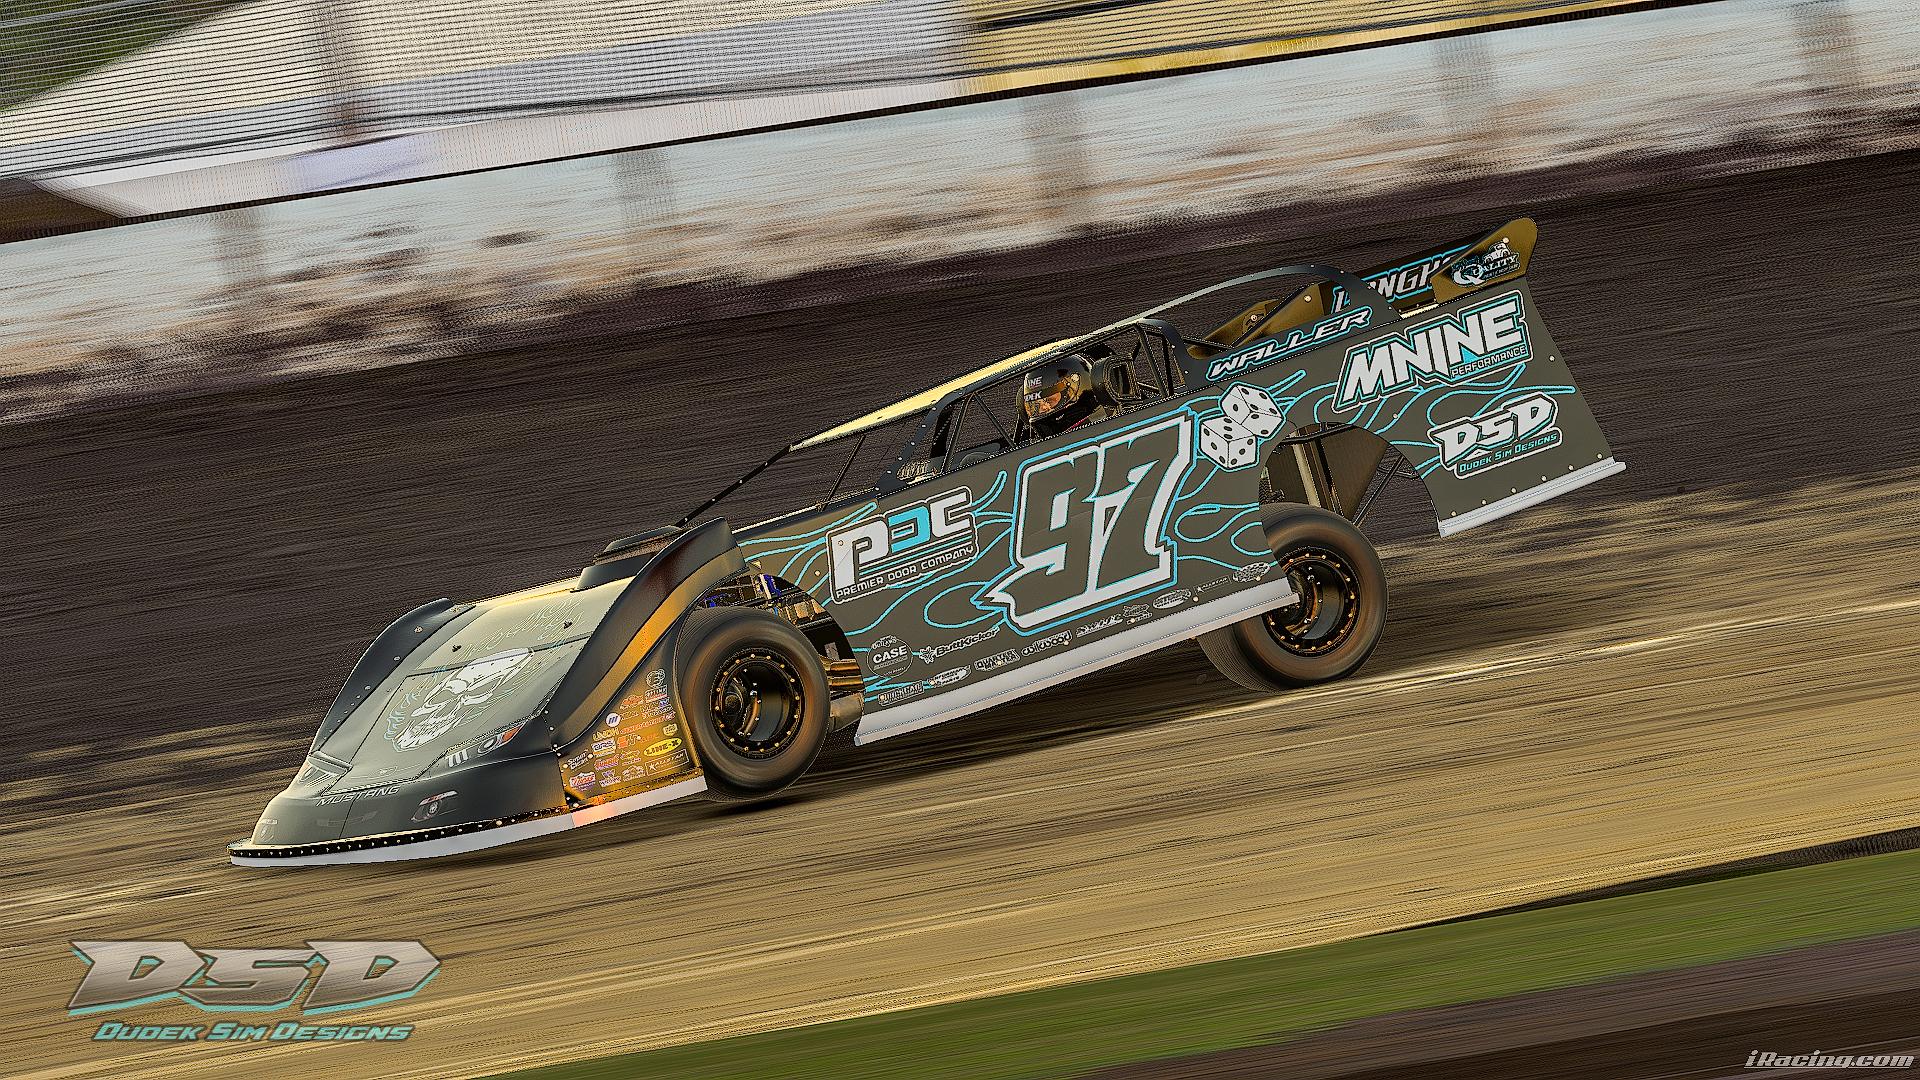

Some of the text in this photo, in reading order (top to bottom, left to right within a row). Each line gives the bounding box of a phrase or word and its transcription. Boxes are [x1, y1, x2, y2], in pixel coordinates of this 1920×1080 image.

[1211, 309, 1371, 378] WALLER
[1343, 301, 1523, 402] MNINE
[1451, 345, 1527, 377] PERFORMANCE
[1432, 397, 1554, 464] DSD
[1459, 433, 1558, 474] DUDEK SIM DESIGNS
[984, 415, 1192, 628] 97
[836, 545, 975, 599] PREMIER DOOR COMPANY
[873, 645, 908, 664] CASE
[936, 627, 1000, 658] ButtKicker
[985, 656, 1017, 669] MATER
[646, 739, 680, 756] LINE-X
[316, 785, 401, 807] MUSTANG
